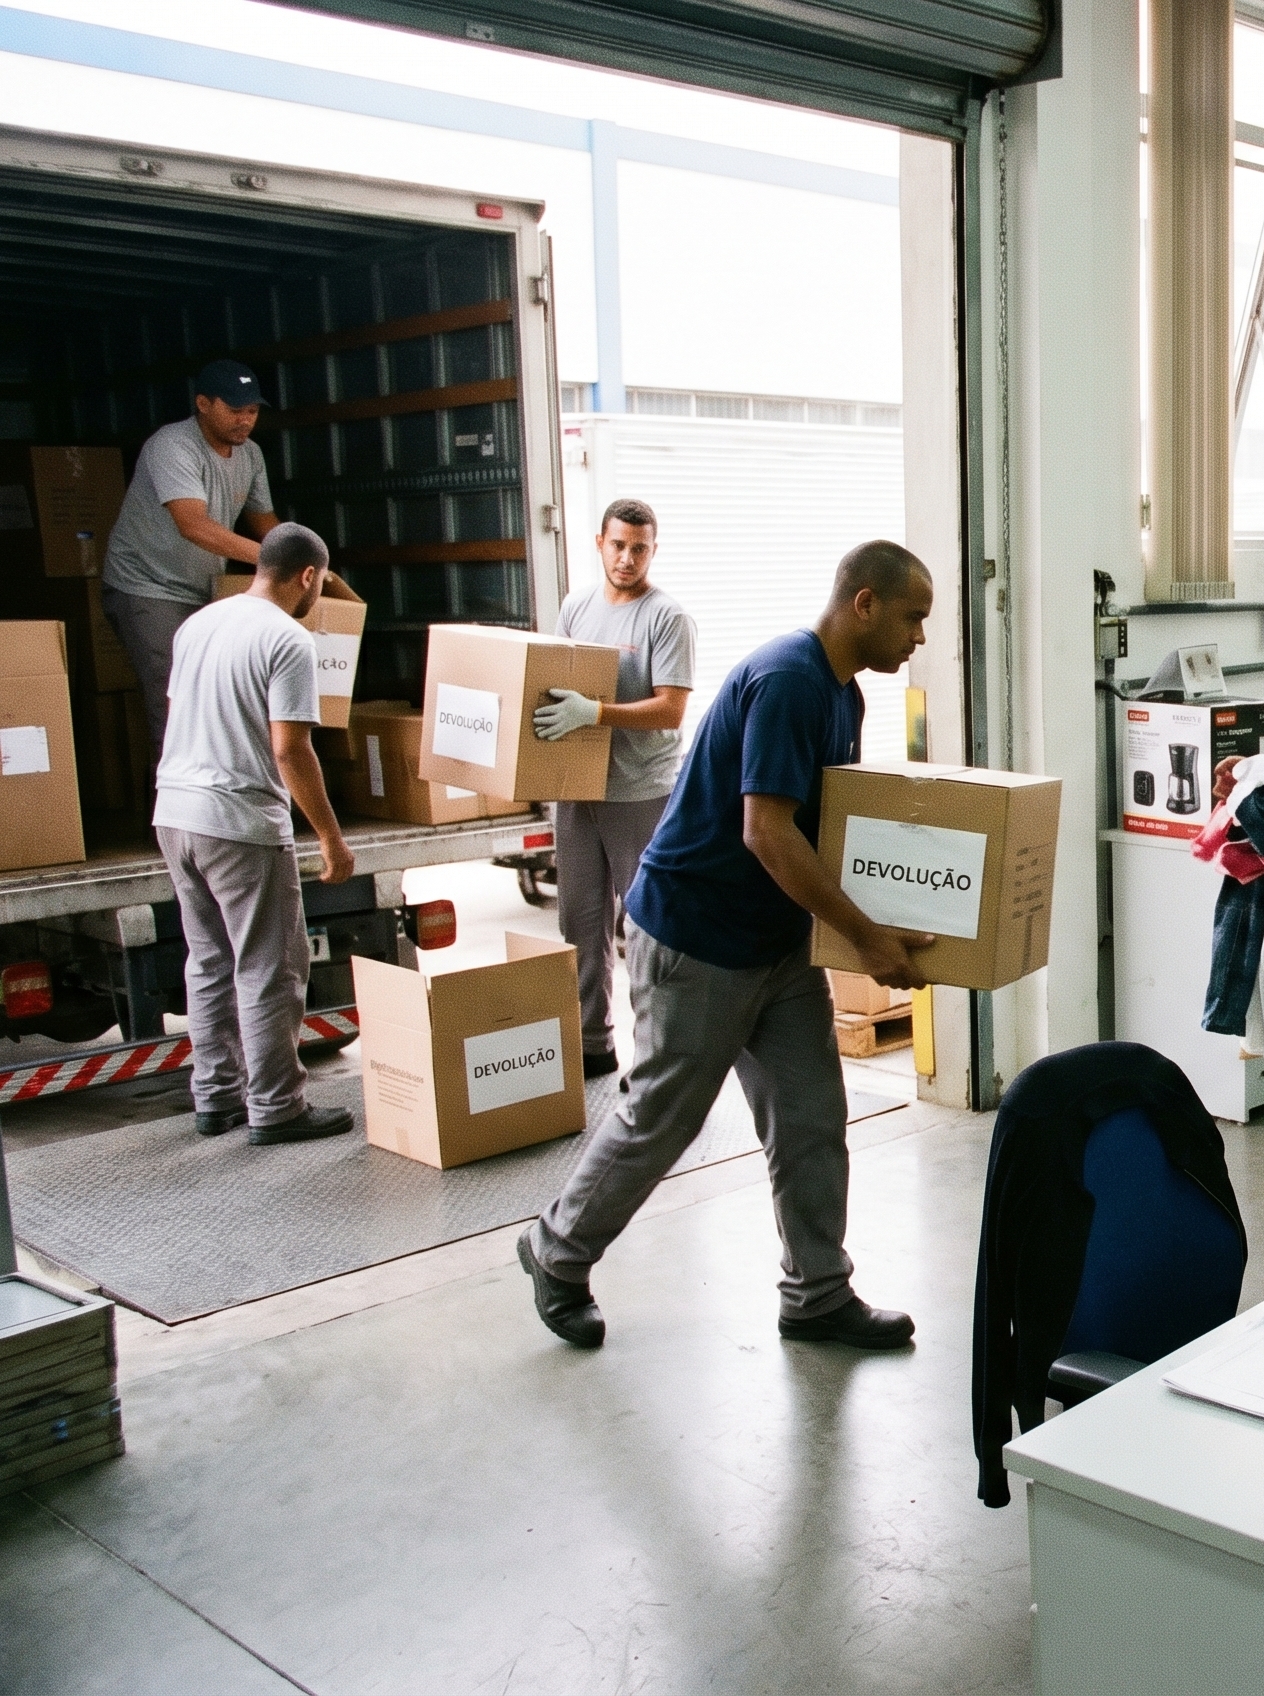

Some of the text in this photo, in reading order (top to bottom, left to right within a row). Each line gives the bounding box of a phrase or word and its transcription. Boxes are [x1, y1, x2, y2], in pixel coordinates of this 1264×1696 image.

[439, 711, 494, 734] DEVOLUÇÃO
[851, 857, 972, 892] DEVOLUÇÃO
[473, 1047, 556, 1080] DEVOLUÇÃO
